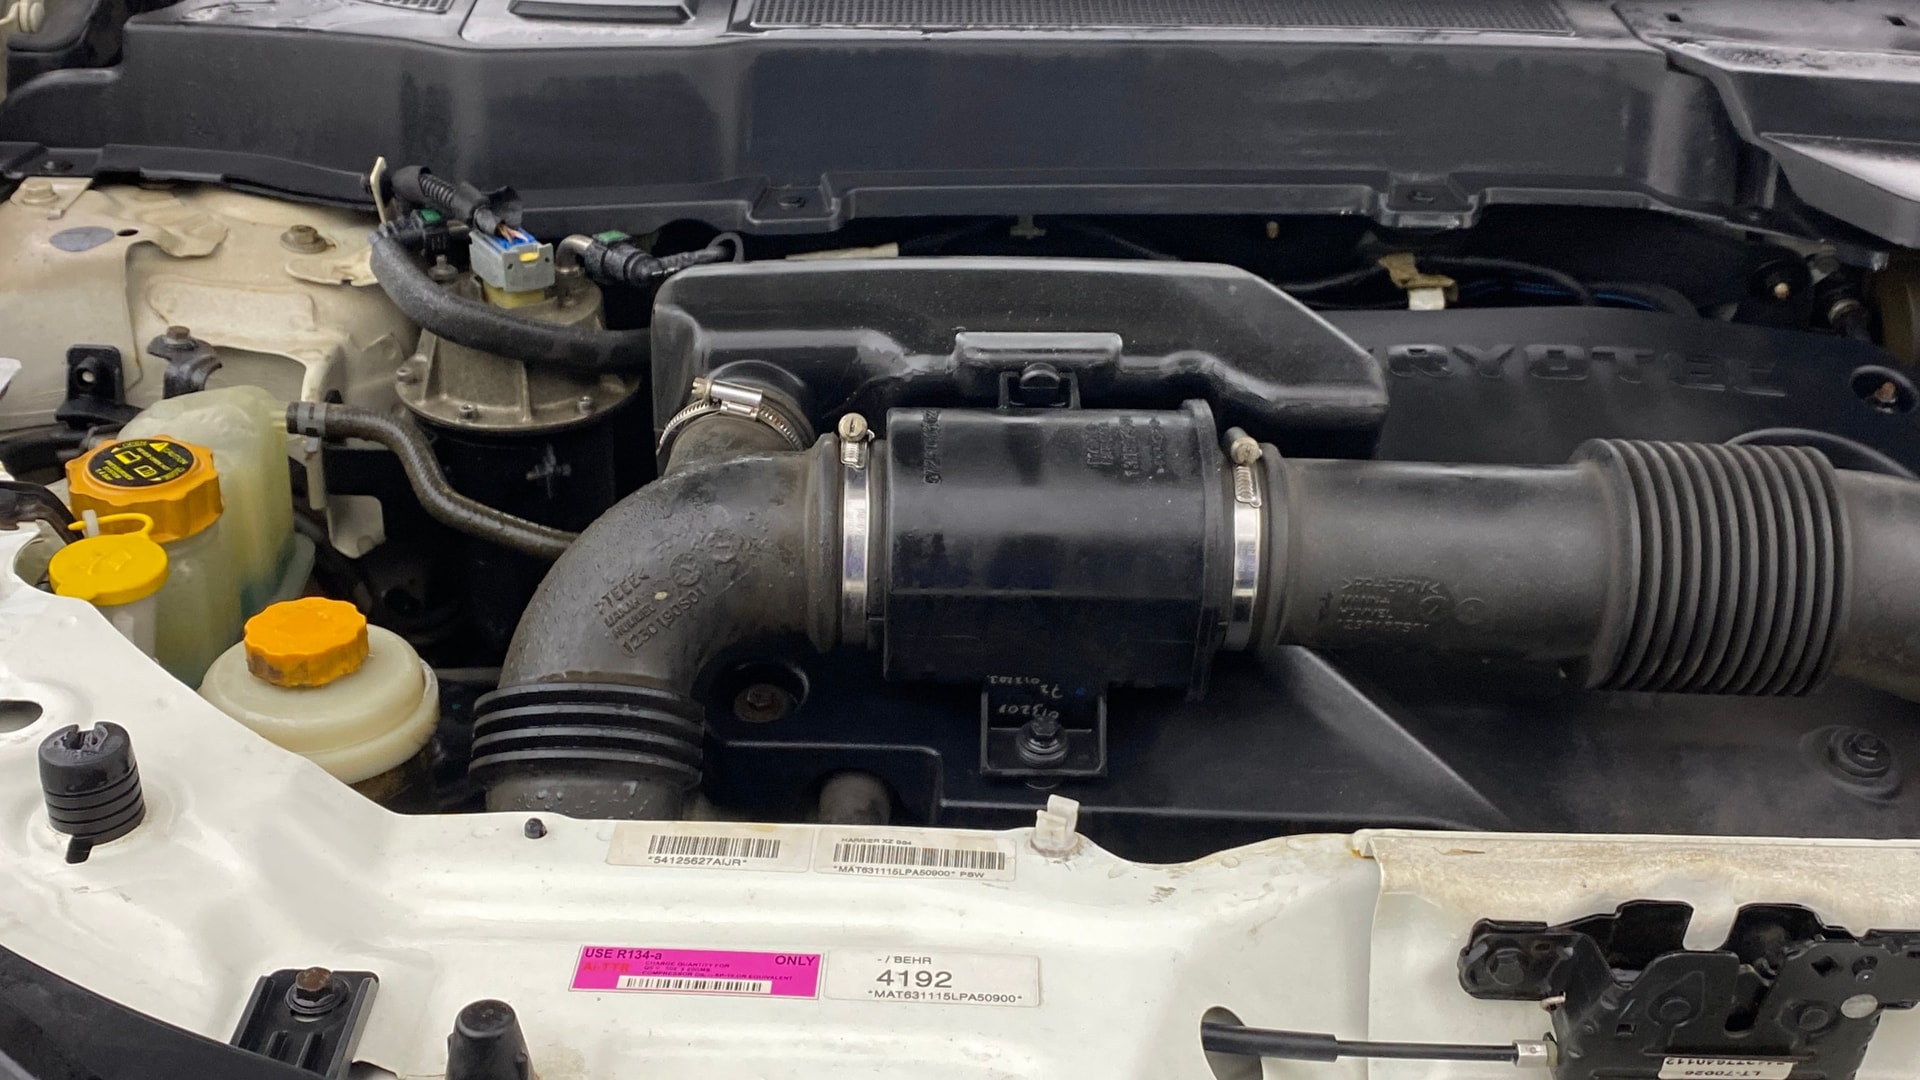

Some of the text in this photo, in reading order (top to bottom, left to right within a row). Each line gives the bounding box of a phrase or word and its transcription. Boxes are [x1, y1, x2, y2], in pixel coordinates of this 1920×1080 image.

[1387, 344, 1786, 396] RYOTEC
[585, 947, 816, 967] USE R134-a ONLY
[893, 955, 932, 965] BEHR
[876, 968, 953, 988] 4192
